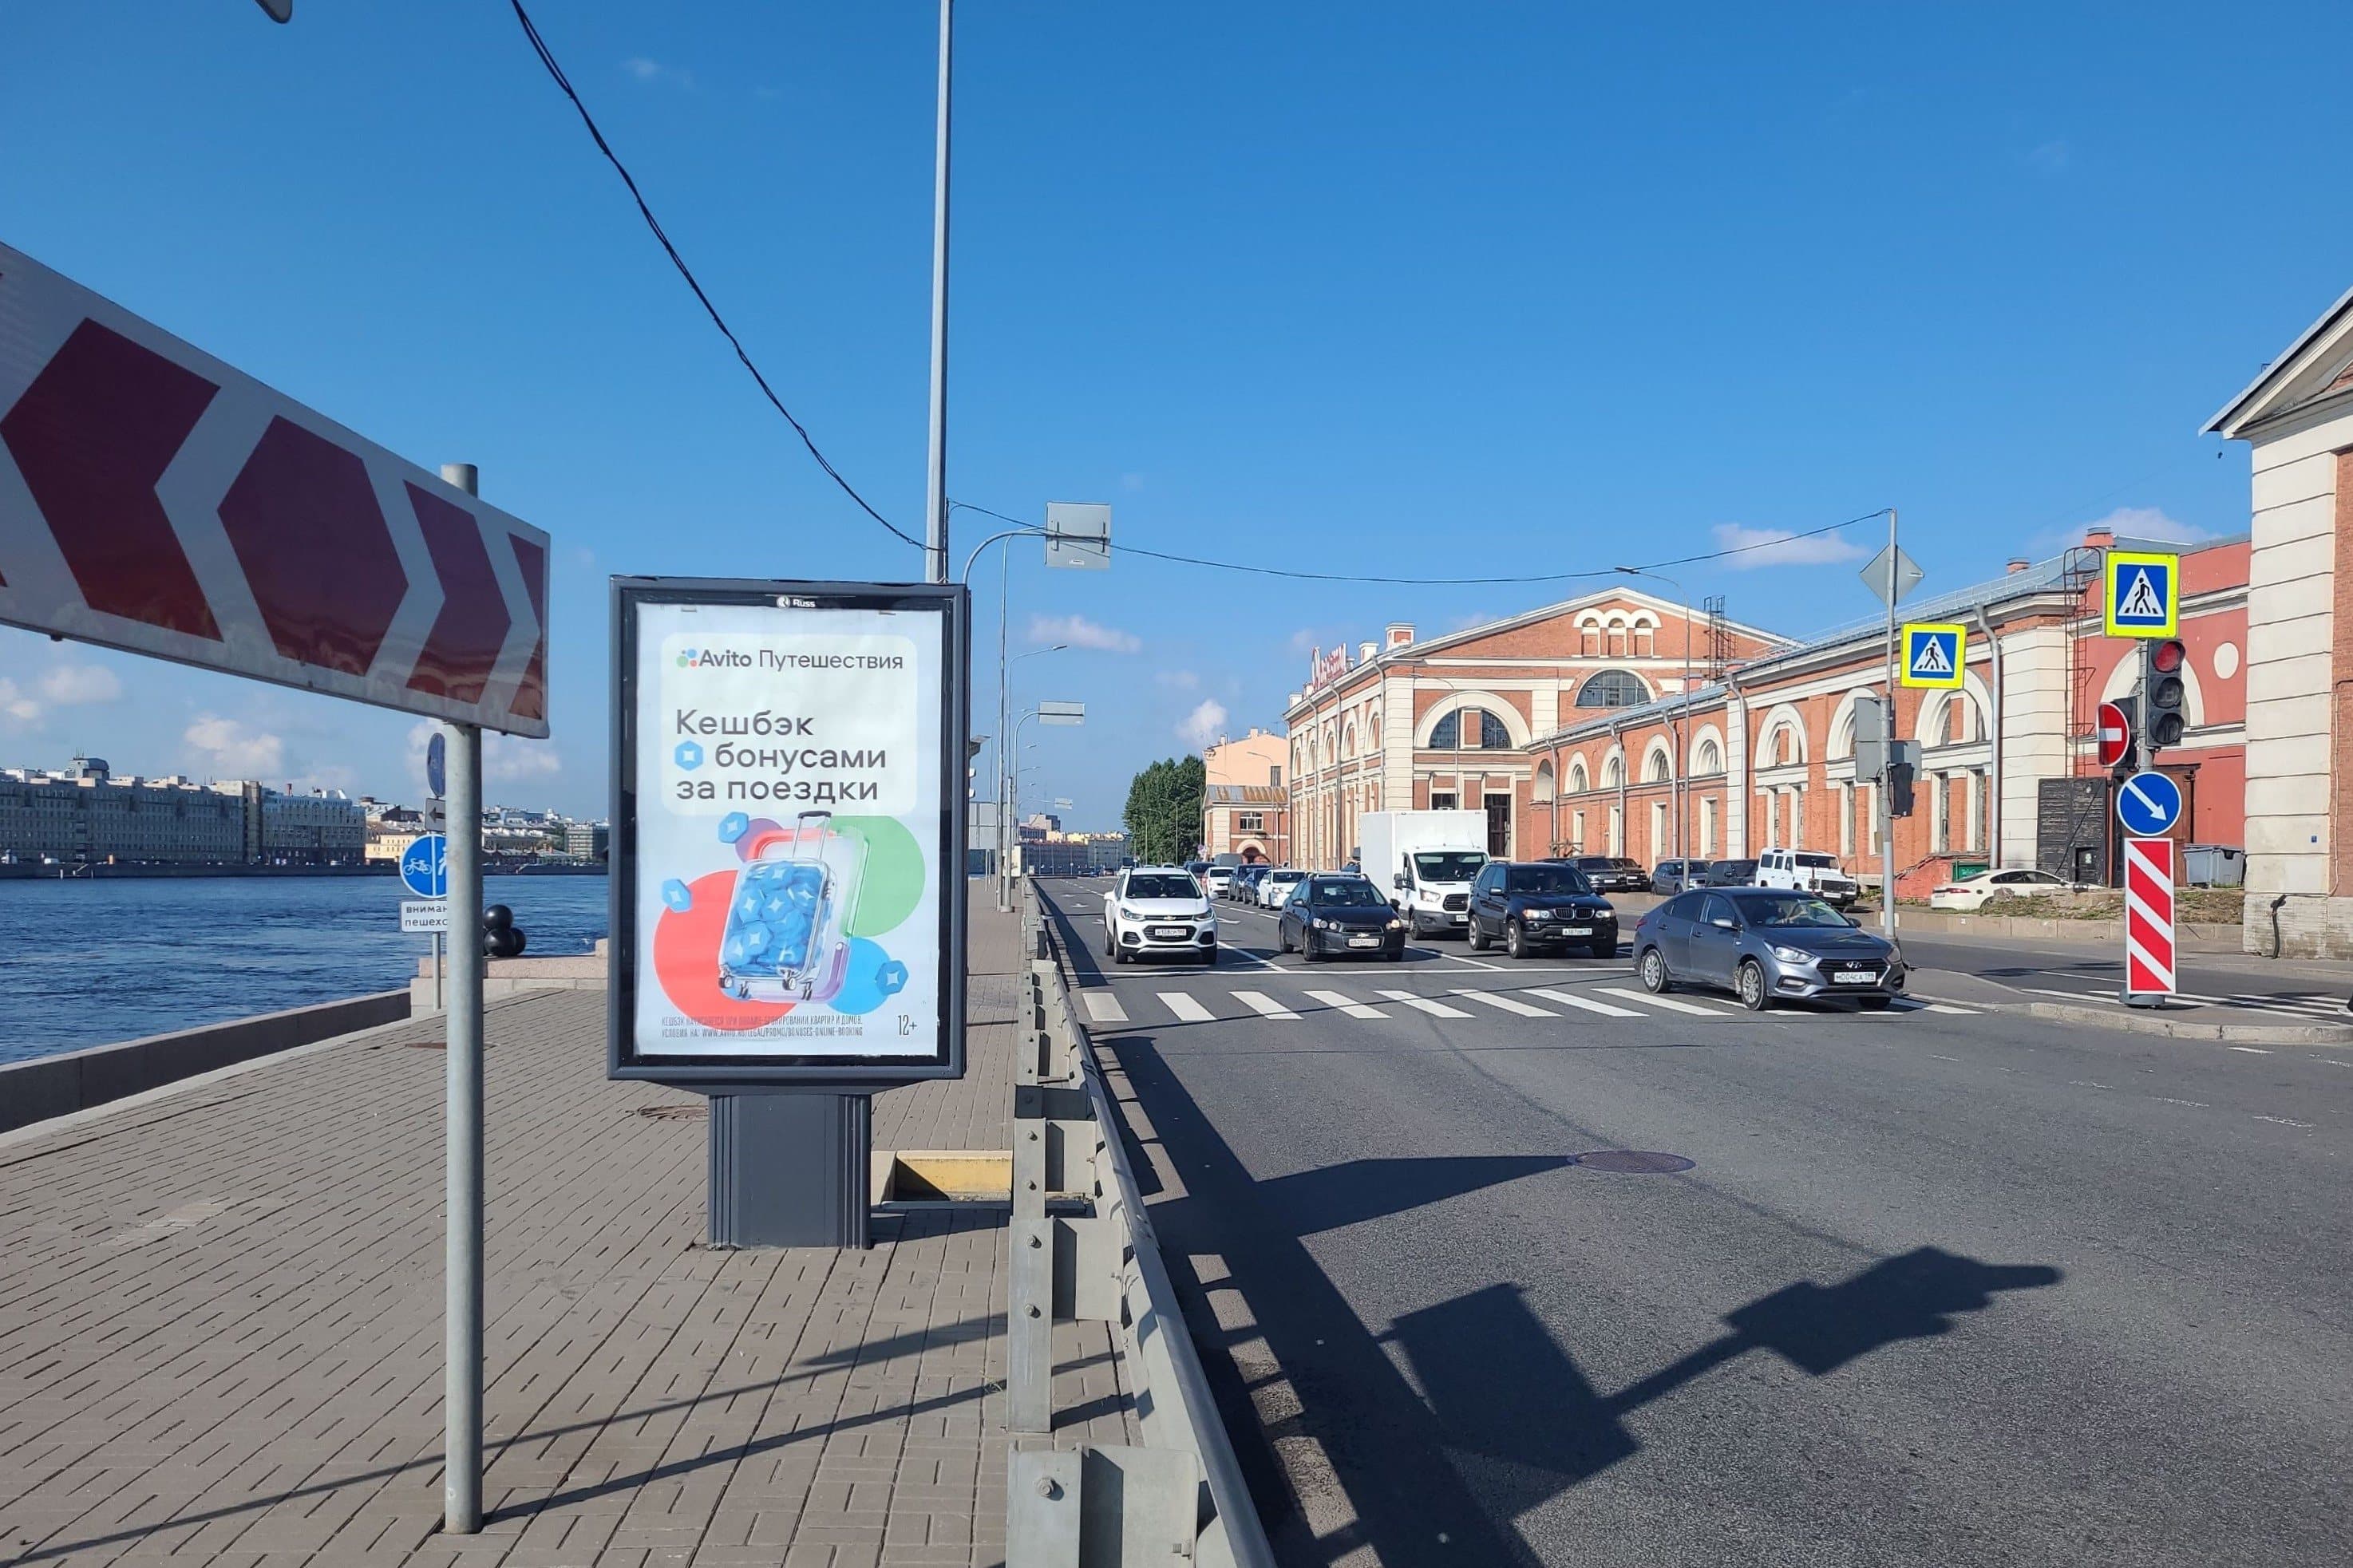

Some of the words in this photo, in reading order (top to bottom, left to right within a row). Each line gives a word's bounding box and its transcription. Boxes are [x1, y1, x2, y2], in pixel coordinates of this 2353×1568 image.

[793, 598, 816, 607] Russ
[698, 649, 752, 668] Avito
[759, 650, 904, 672] Путешествия
[676, 709, 814, 736] Кешбэк
[715, 741, 887, 775] бонусами
[676, 780, 715, 800] за
[728, 780, 878, 804] поездки
[898, 1014, 918, 1036] 12+
